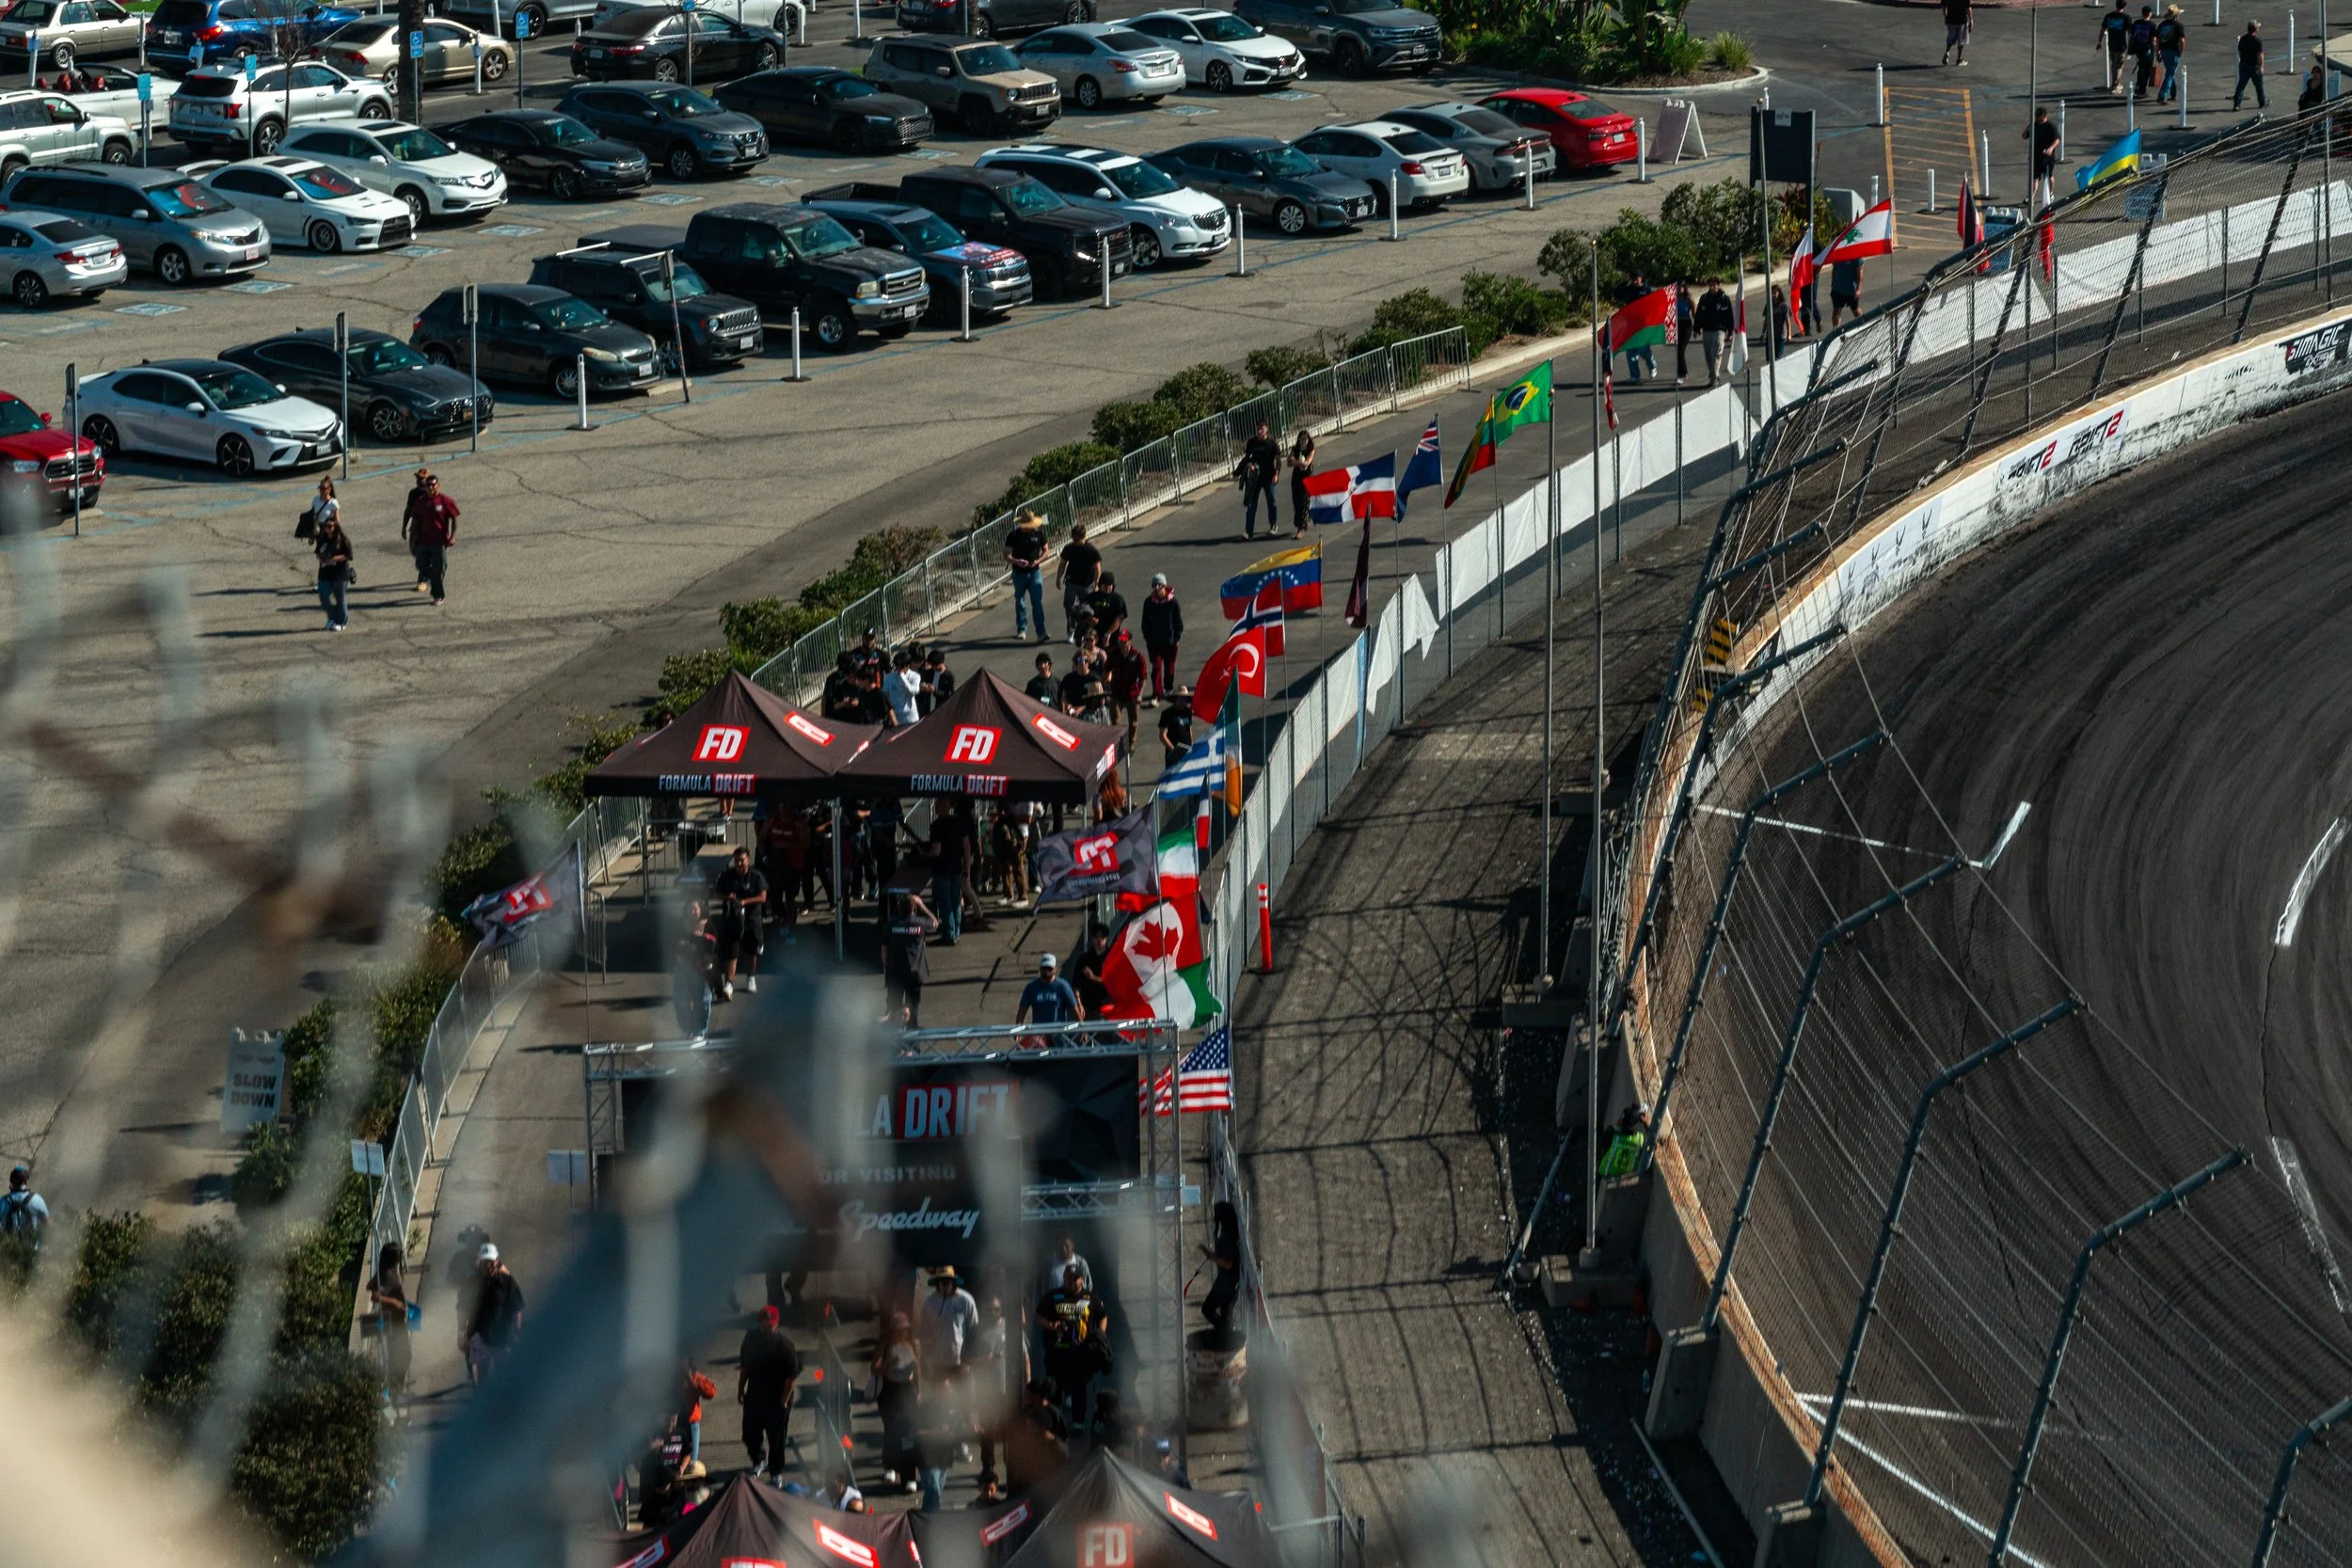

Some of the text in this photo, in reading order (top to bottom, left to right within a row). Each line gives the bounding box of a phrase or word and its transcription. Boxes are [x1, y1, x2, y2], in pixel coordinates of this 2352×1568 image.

[699, 727, 742, 760] FD
[950, 727, 994, 762] FD
[659, 774, 755, 793] FORMULA DRIFT
[911, 774, 1007, 795] FORMULA DRIFT
[233, 1073, 277, 1090] SLOW
[230, 1091, 275, 1108] DOWN
[904, 1085, 1009, 1139] DRIFT
[860, 1165, 957, 1183] VISITING
[838, 1196, 980, 1243] Speedway
[1085, 1526, 1127, 1567] FD
